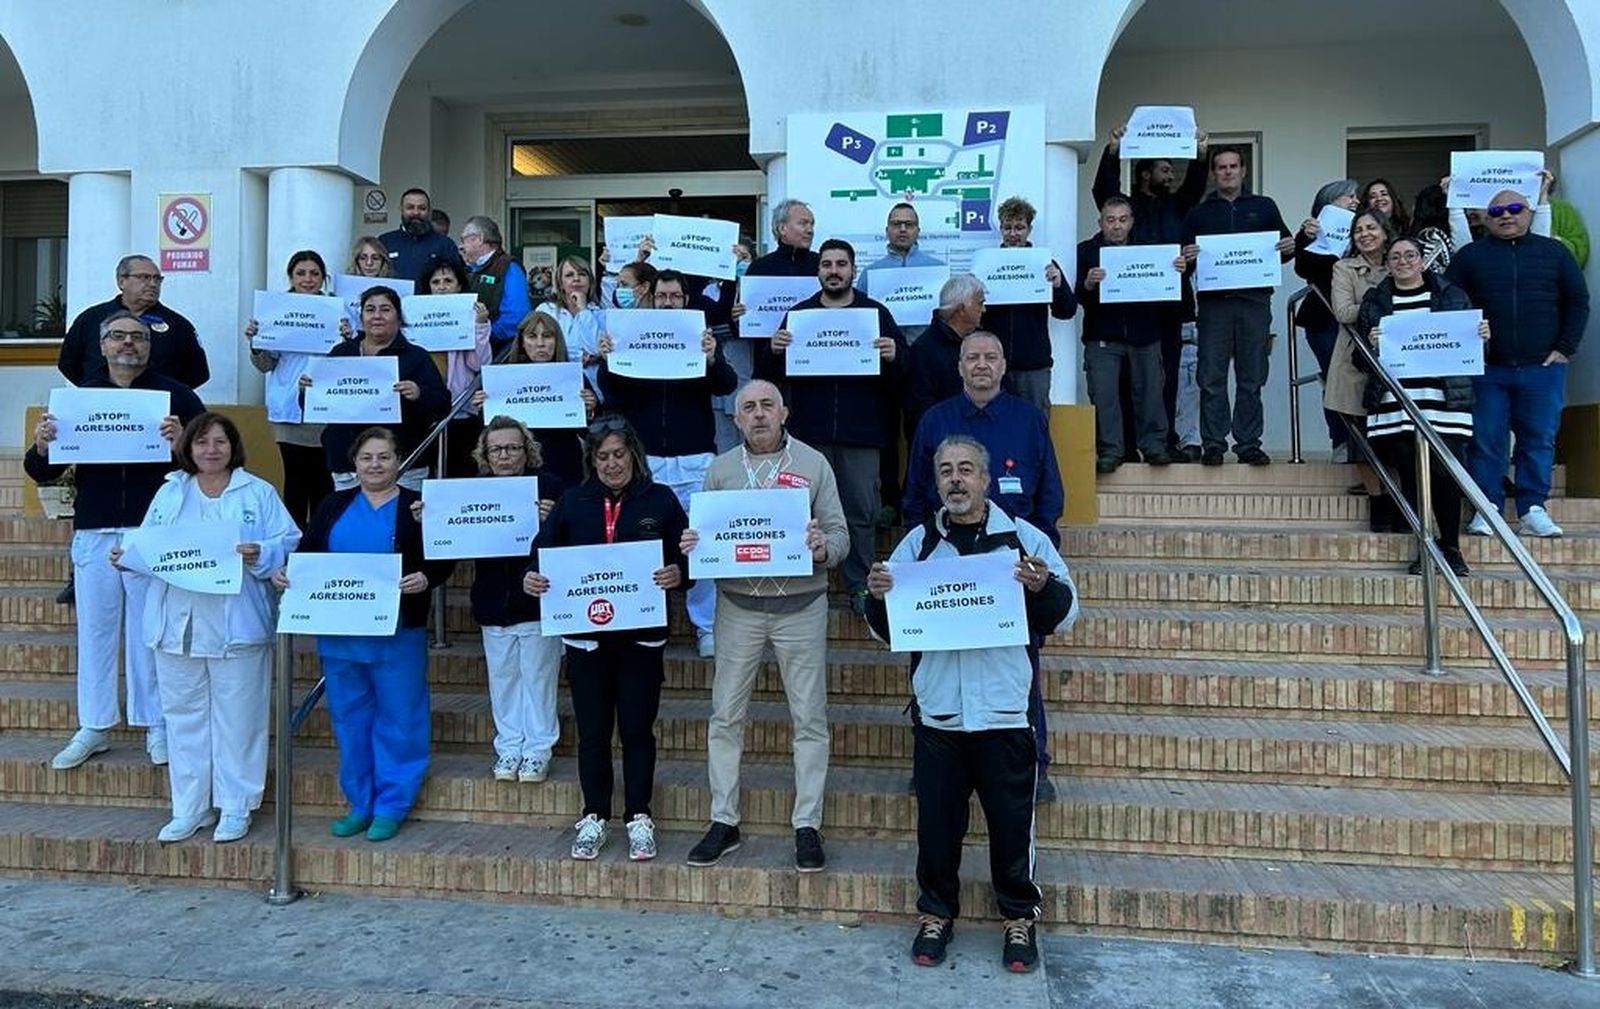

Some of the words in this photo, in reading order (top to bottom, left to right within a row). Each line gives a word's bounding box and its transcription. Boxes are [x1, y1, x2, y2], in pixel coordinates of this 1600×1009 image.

[976, 120, 996, 134] P2
[842, 136, 862, 150] P3
[1469, 177, 1522, 185] AGRESIONES
[966, 211, 984, 224] P1
[670, 241, 720, 253] AGRESIONES
[1214, 259, 1263, 267] AGRESIONES
[987, 274, 1035, 282] AGRESIONES
[886, 294, 934, 303] AGRESIONES
[273, 319, 326, 329] AGRESIONES
[414, 320, 459, 328] AGRESIONES
[628, 342, 686, 350] AGRESIONES
[806, 340, 861, 348] AGRESIONES
[1401, 342, 1462, 352] AGRESIONES
[326, 388, 380, 396] AGRESIONES
[505, 395, 564, 404] AGRESIONES
[88, 412, 131, 422] ¡¡STOP!!
[74, 424, 144, 432] AGRESIONES
[460, 503, 501, 514] ¡¡STOP!!
[447, 514, 516, 526] AGRESIONES
[728, 518, 772, 528] ¡¡STOP!!
[714, 530, 786, 541] AGRESIONES
[160, 549, 202, 563] ¡¡STOP!!
[580, 571, 624, 584] ¡¡STOP!!
[324, 579, 365, 590] ¡¡STOP!!
[930, 582, 978, 596] ¡¡STOP!!
[566, 584, 639, 598] AGRESIONES
[309, 592, 376, 601] AGRESIONES
[916, 596, 995, 611] AGRESIONES
